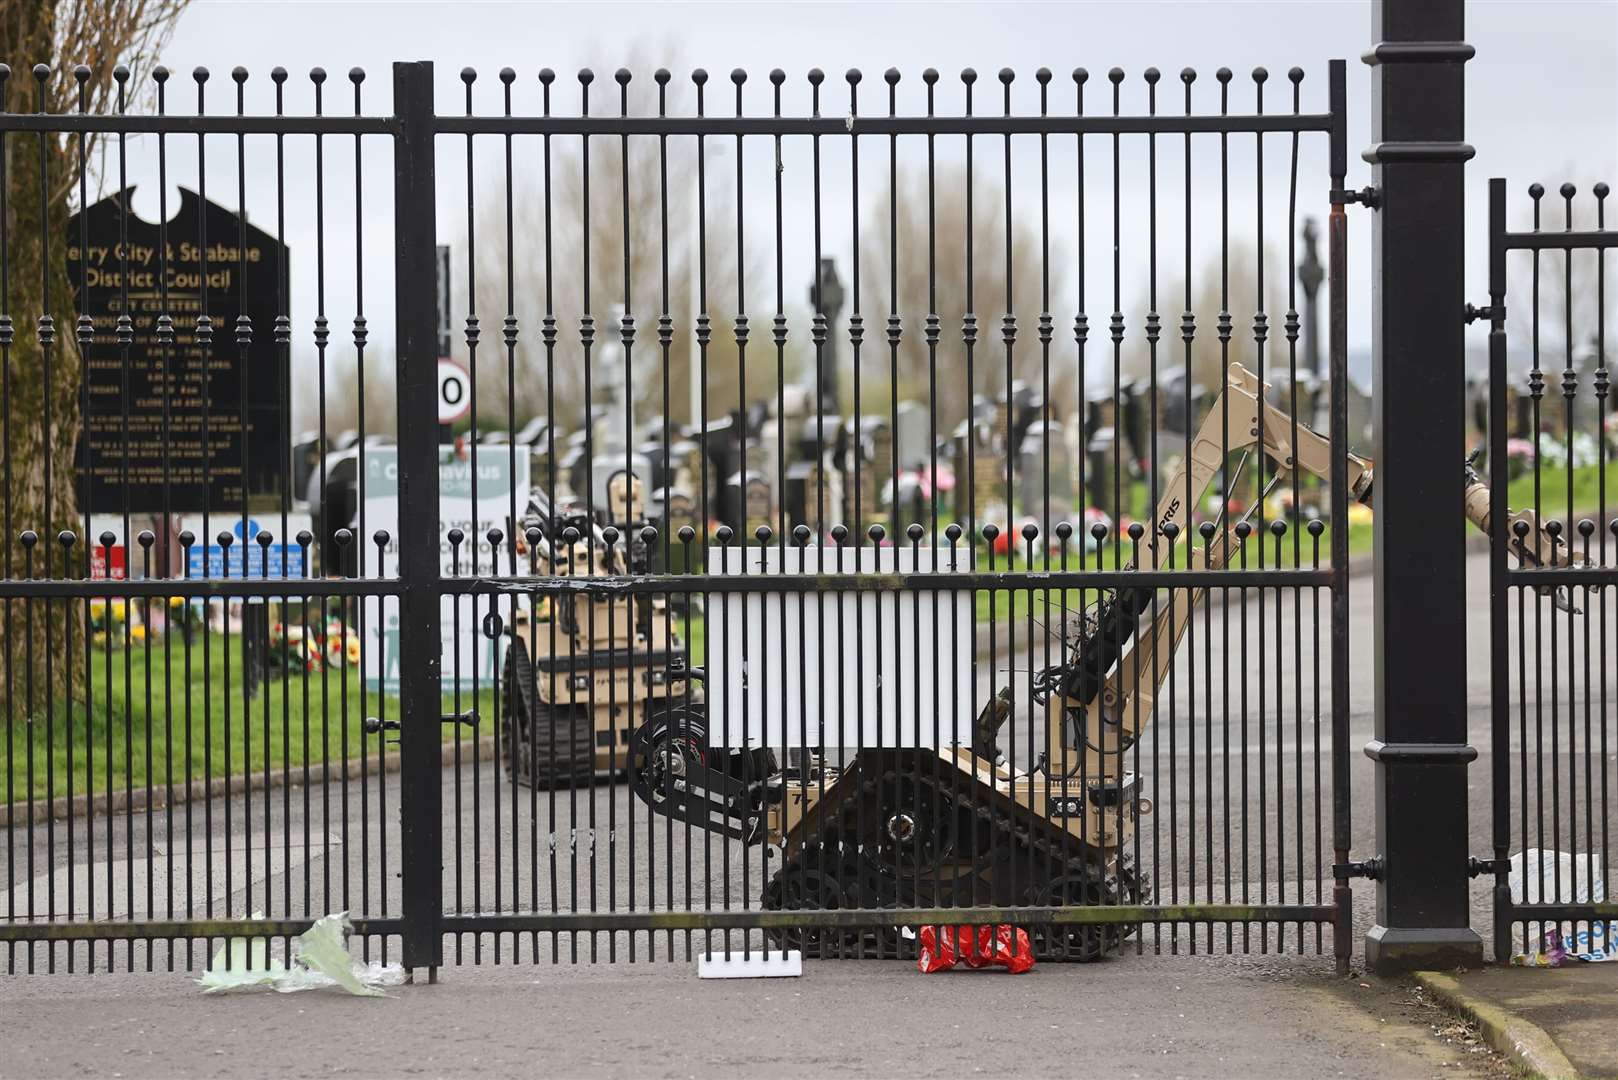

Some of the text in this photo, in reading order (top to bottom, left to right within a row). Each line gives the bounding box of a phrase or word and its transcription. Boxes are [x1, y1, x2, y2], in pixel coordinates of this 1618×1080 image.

[114, 242, 154, 266] City
[180, 242, 260, 262] Stabane
[86, 268, 154, 287] Distict
[442, 377, 463, 405] 0
